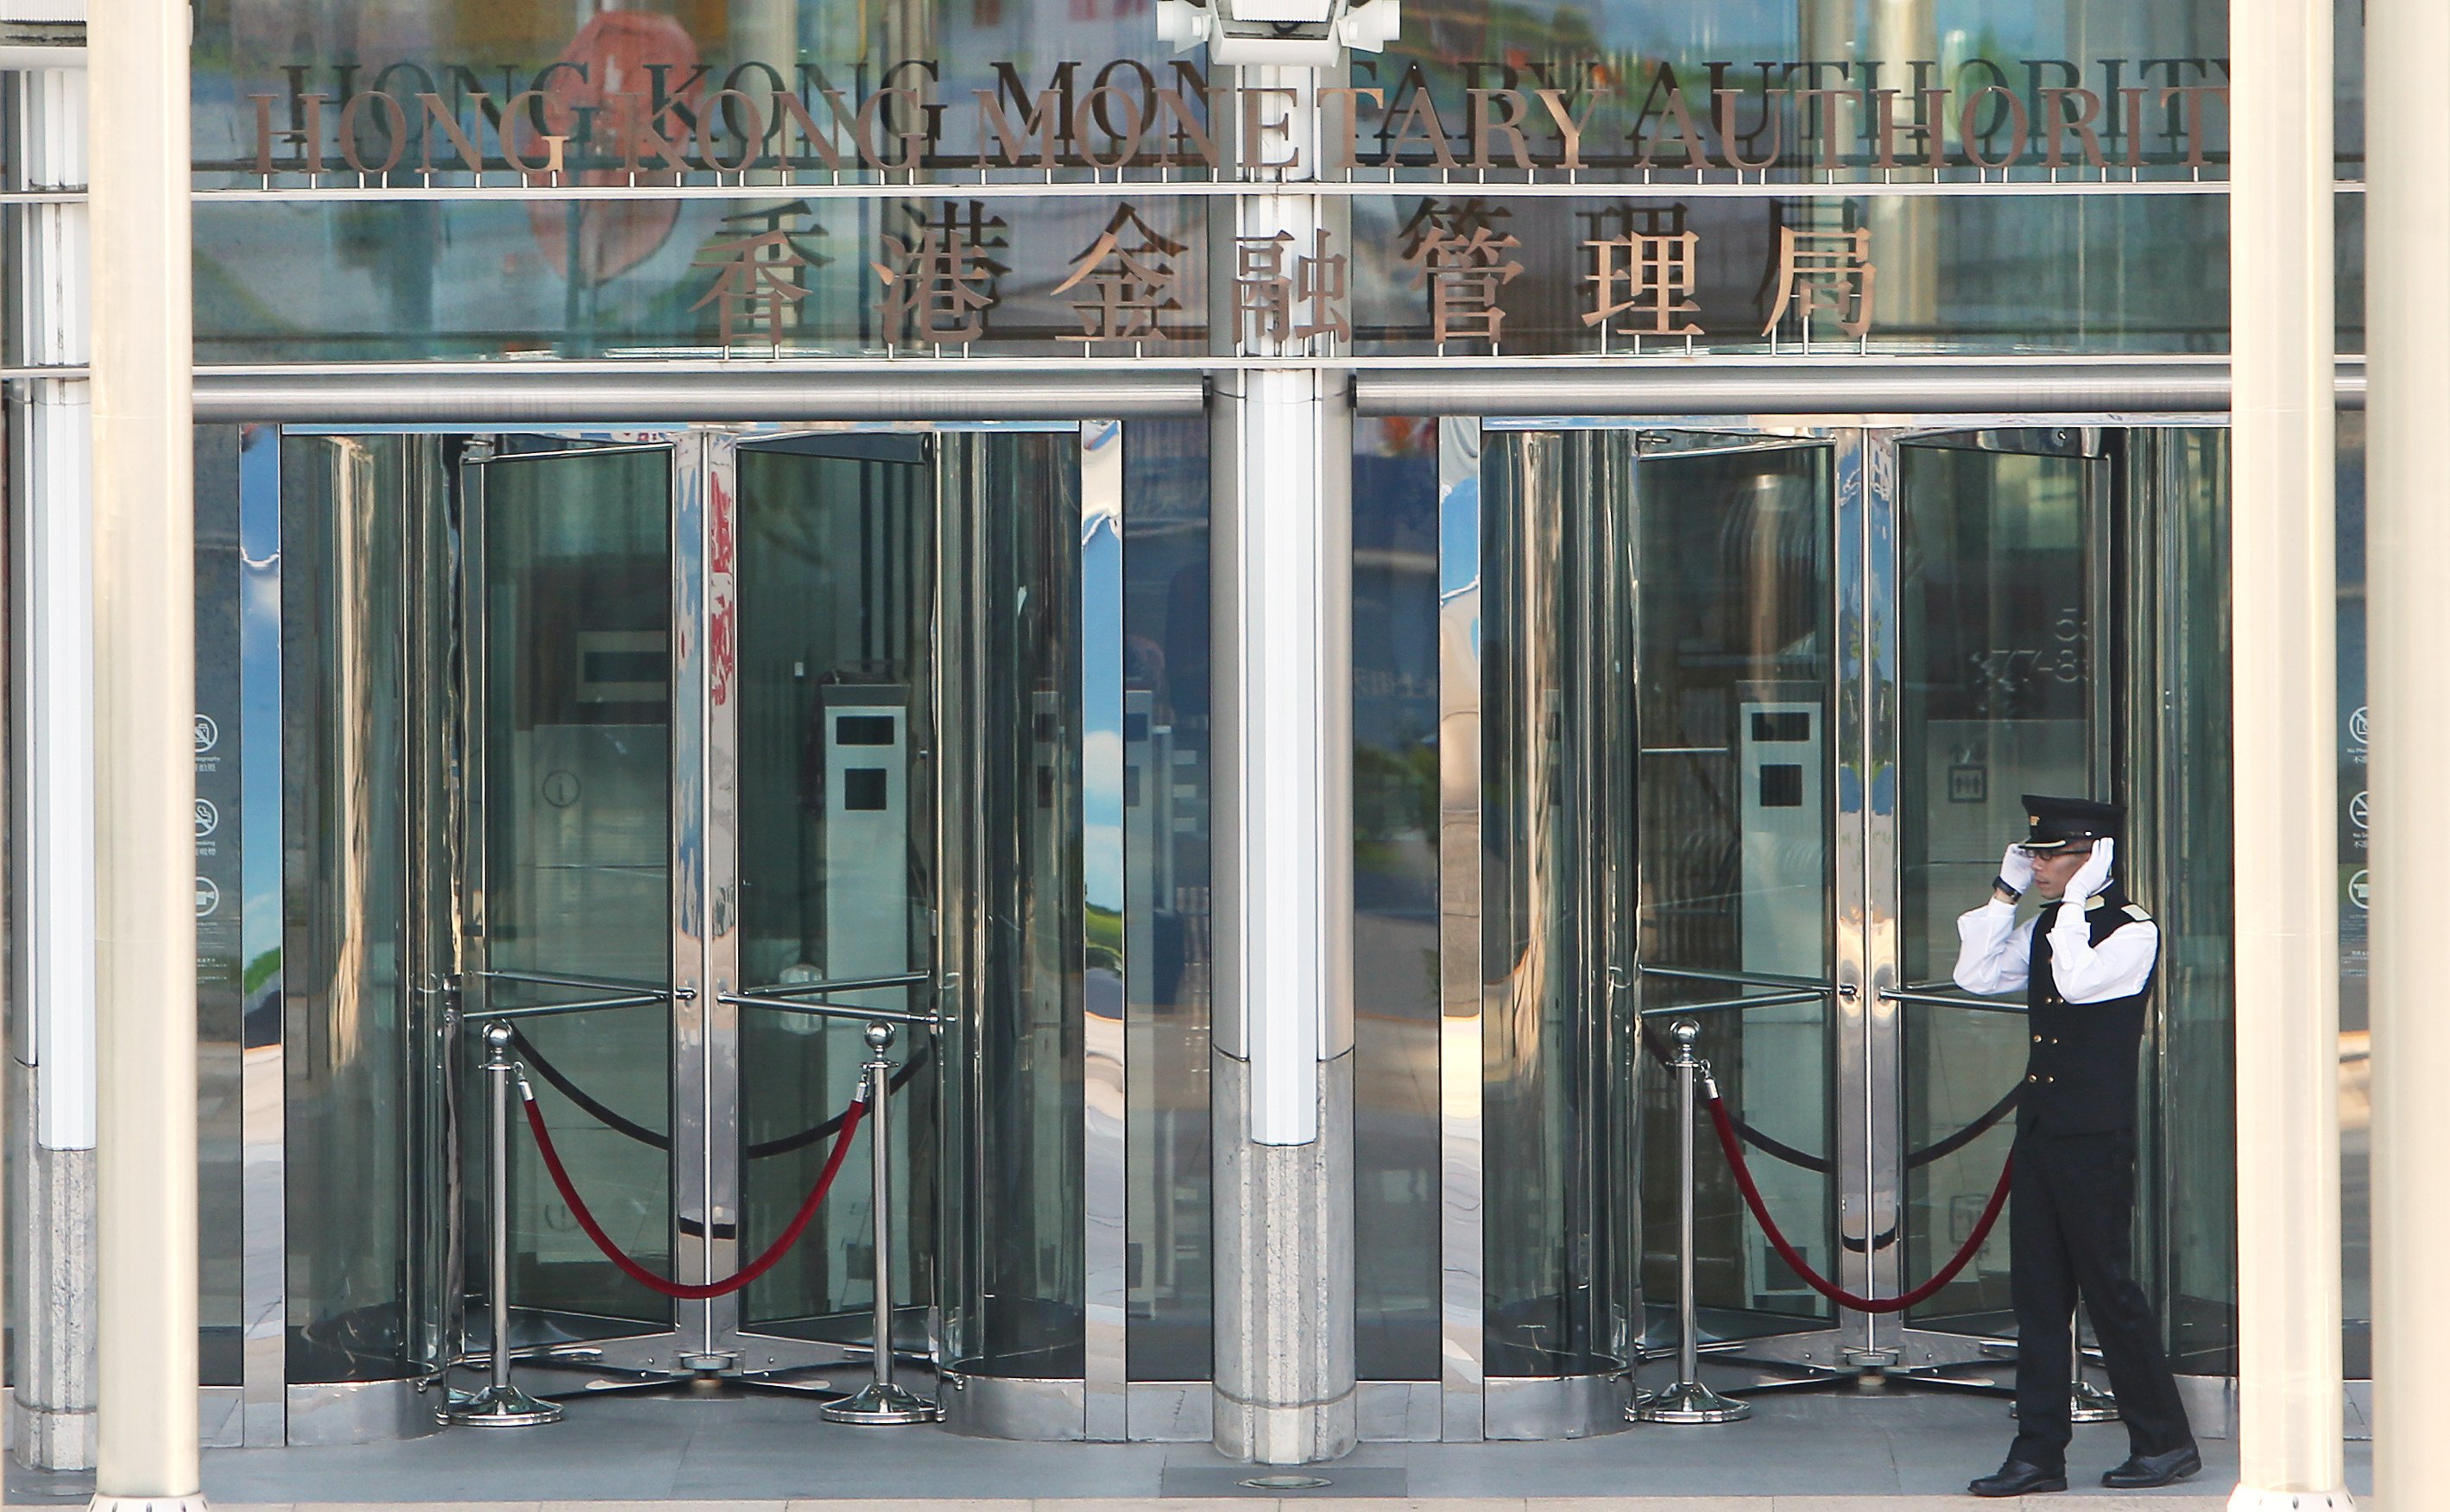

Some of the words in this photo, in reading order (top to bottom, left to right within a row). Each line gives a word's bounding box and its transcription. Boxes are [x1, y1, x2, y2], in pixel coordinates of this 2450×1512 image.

[248, 89, 569, 173] HONG
[616, 88, 925, 173] KONG
[971, 86, 1608, 170] MONETARY
[1635, 85, 2230, 170] AUTHORIT
[690, 226, 1877, 349] 香港金融管理局
